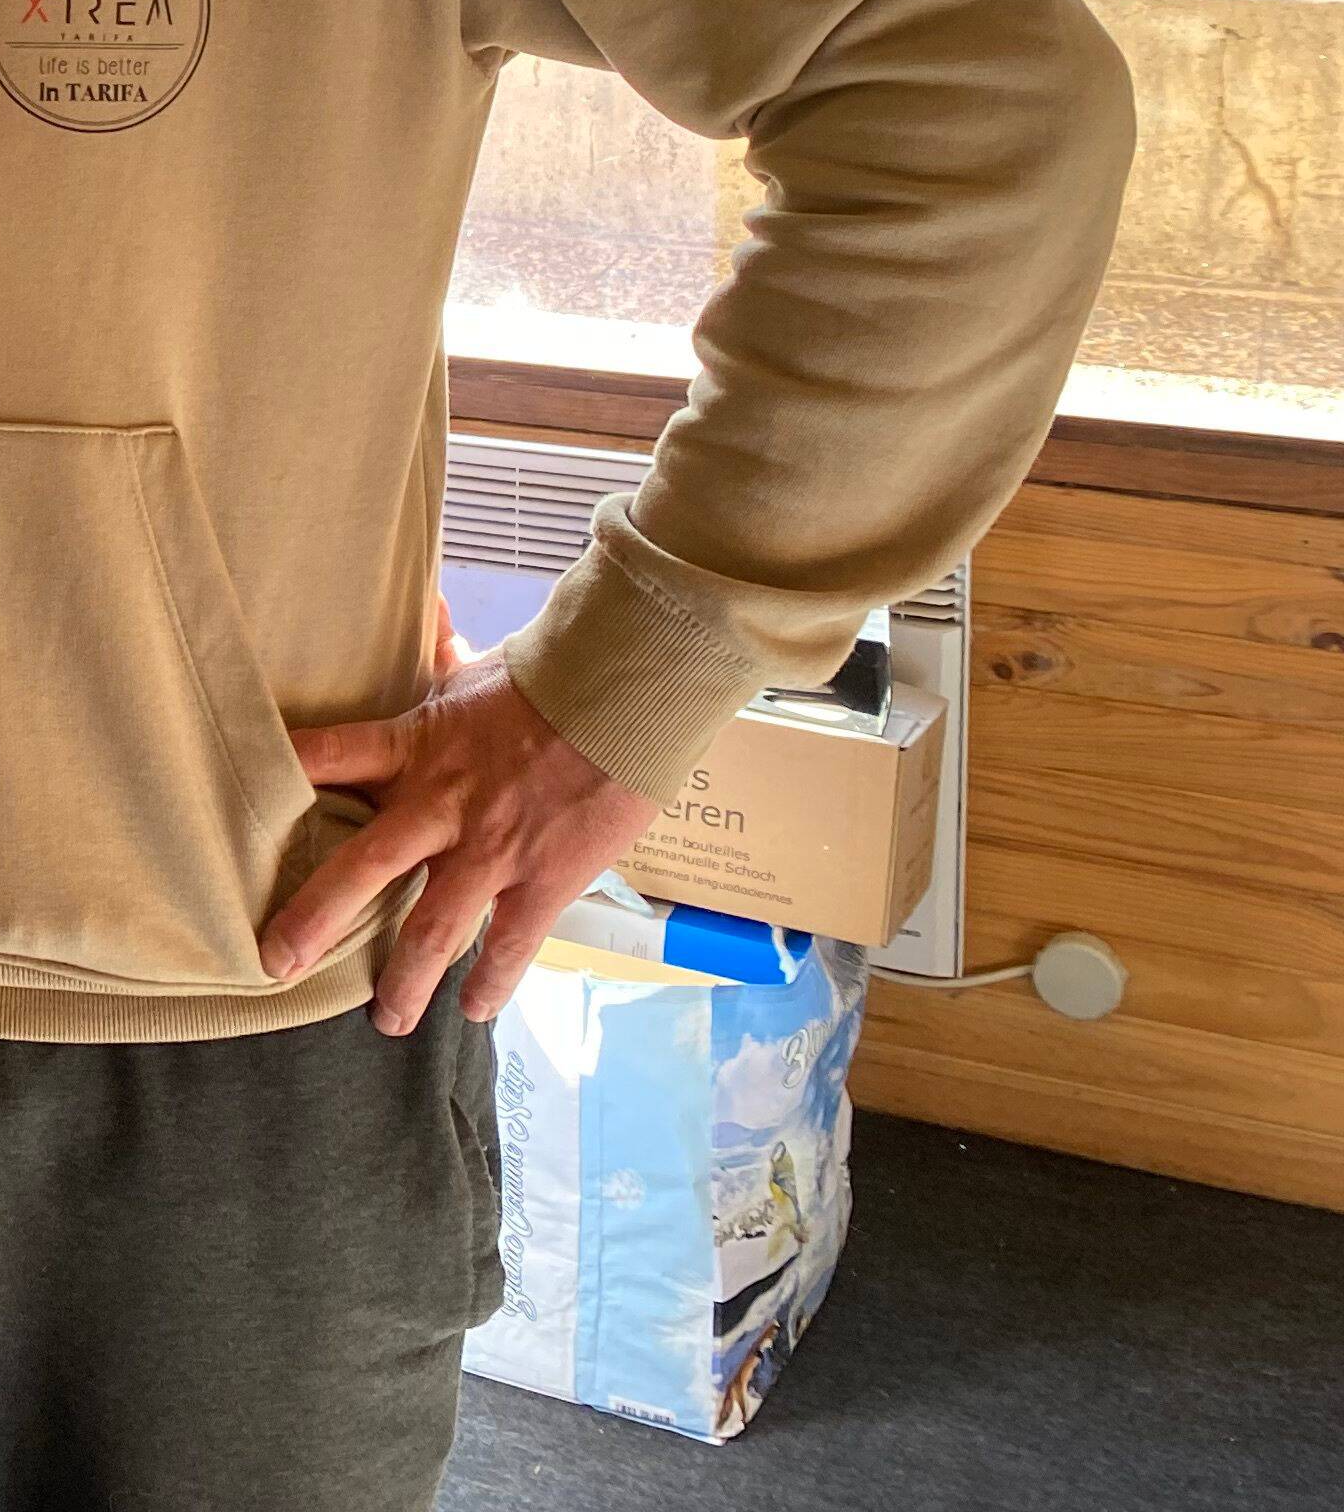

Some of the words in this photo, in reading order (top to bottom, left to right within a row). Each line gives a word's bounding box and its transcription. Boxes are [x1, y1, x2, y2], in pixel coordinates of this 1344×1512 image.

[39, 56, 68, 75] life
[76, 57, 90, 75] is
[97, 57, 151, 77] better
[65, 83, 149, 103] TARIFA
[633, 840, 720, 871] Emmanuelle
[683, 837, 751, 863] bouteilles
